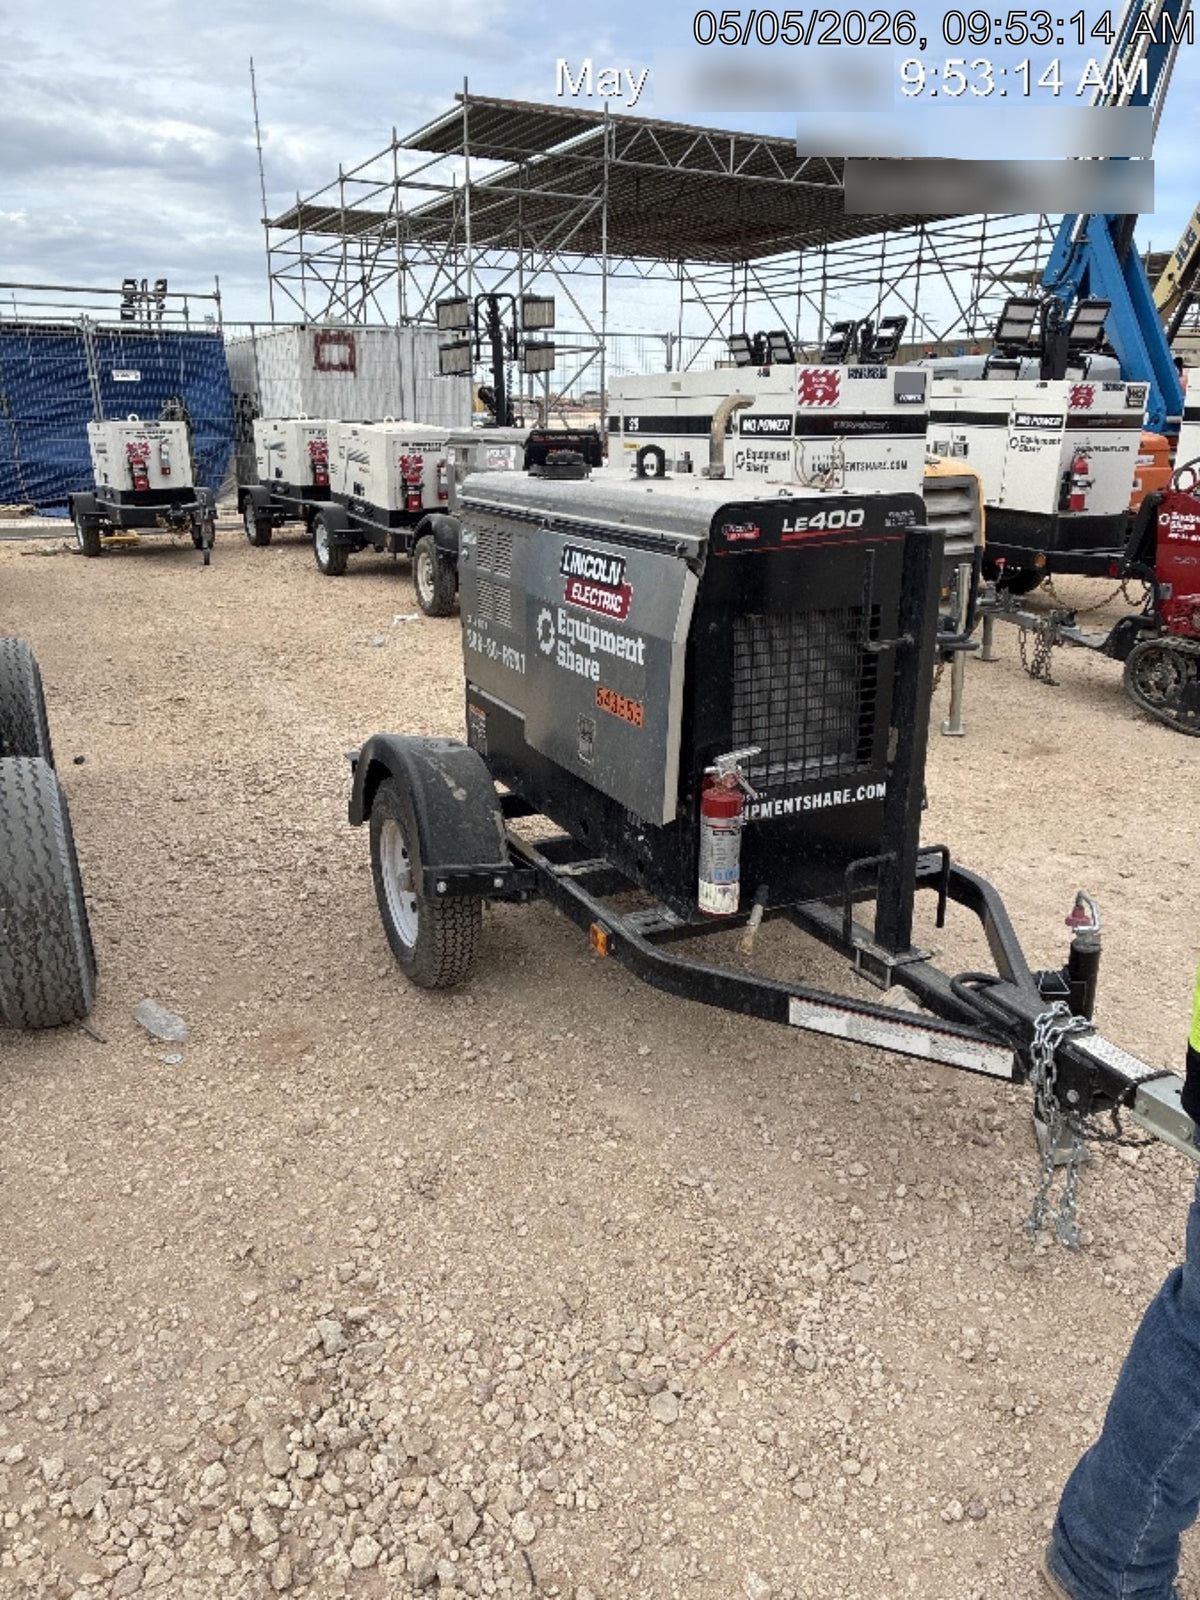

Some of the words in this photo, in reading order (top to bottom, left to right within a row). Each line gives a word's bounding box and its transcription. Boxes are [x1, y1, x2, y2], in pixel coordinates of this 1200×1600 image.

[757, 419, 790, 432] POWER
[781, 509, 866, 534] LE400
[563, 549, 622, 587] LINCOLN
[570, 581, 623, 614] ELECTRIC
[557, 608, 646, 665] Equipment
[556, 641, 601, 682] Share
[743, 781, 887, 821] IPMENTSHARE.COM
